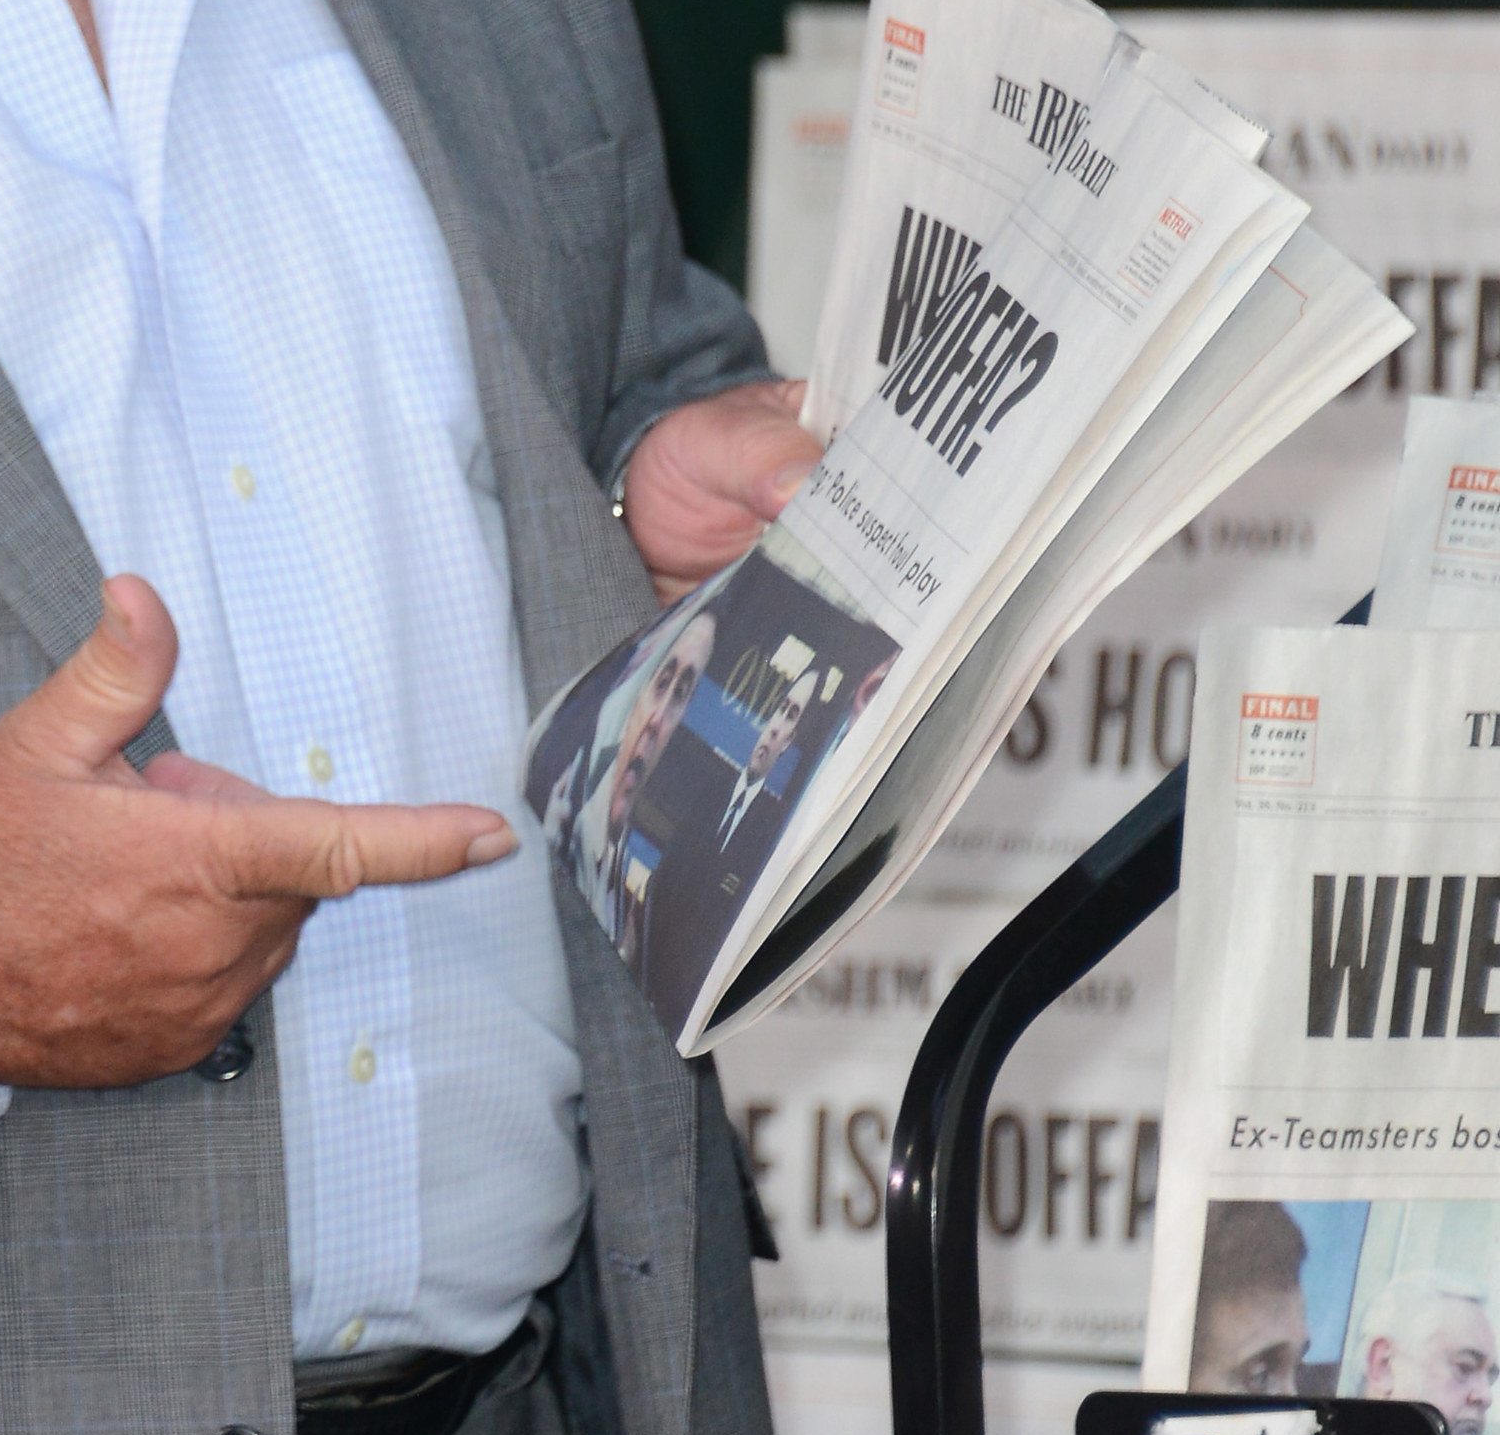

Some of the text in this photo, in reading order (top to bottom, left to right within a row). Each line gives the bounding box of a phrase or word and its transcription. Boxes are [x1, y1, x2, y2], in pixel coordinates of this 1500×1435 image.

[990, 74, 1032, 127] THE
[1384, 266, 1500, 394] FFA
[897, 556, 942, 606] play
[1245, 698, 1313, 717] FINAL
[1267, 727, 1309, 742] cents
[1305, 873, 1500, 1039] WHE
[1228, 1115, 1442, 1151] Ex-Teamsters
[811, 1101, 889, 1233] IS
[982, 1108, 1162, 1244] OFFA
